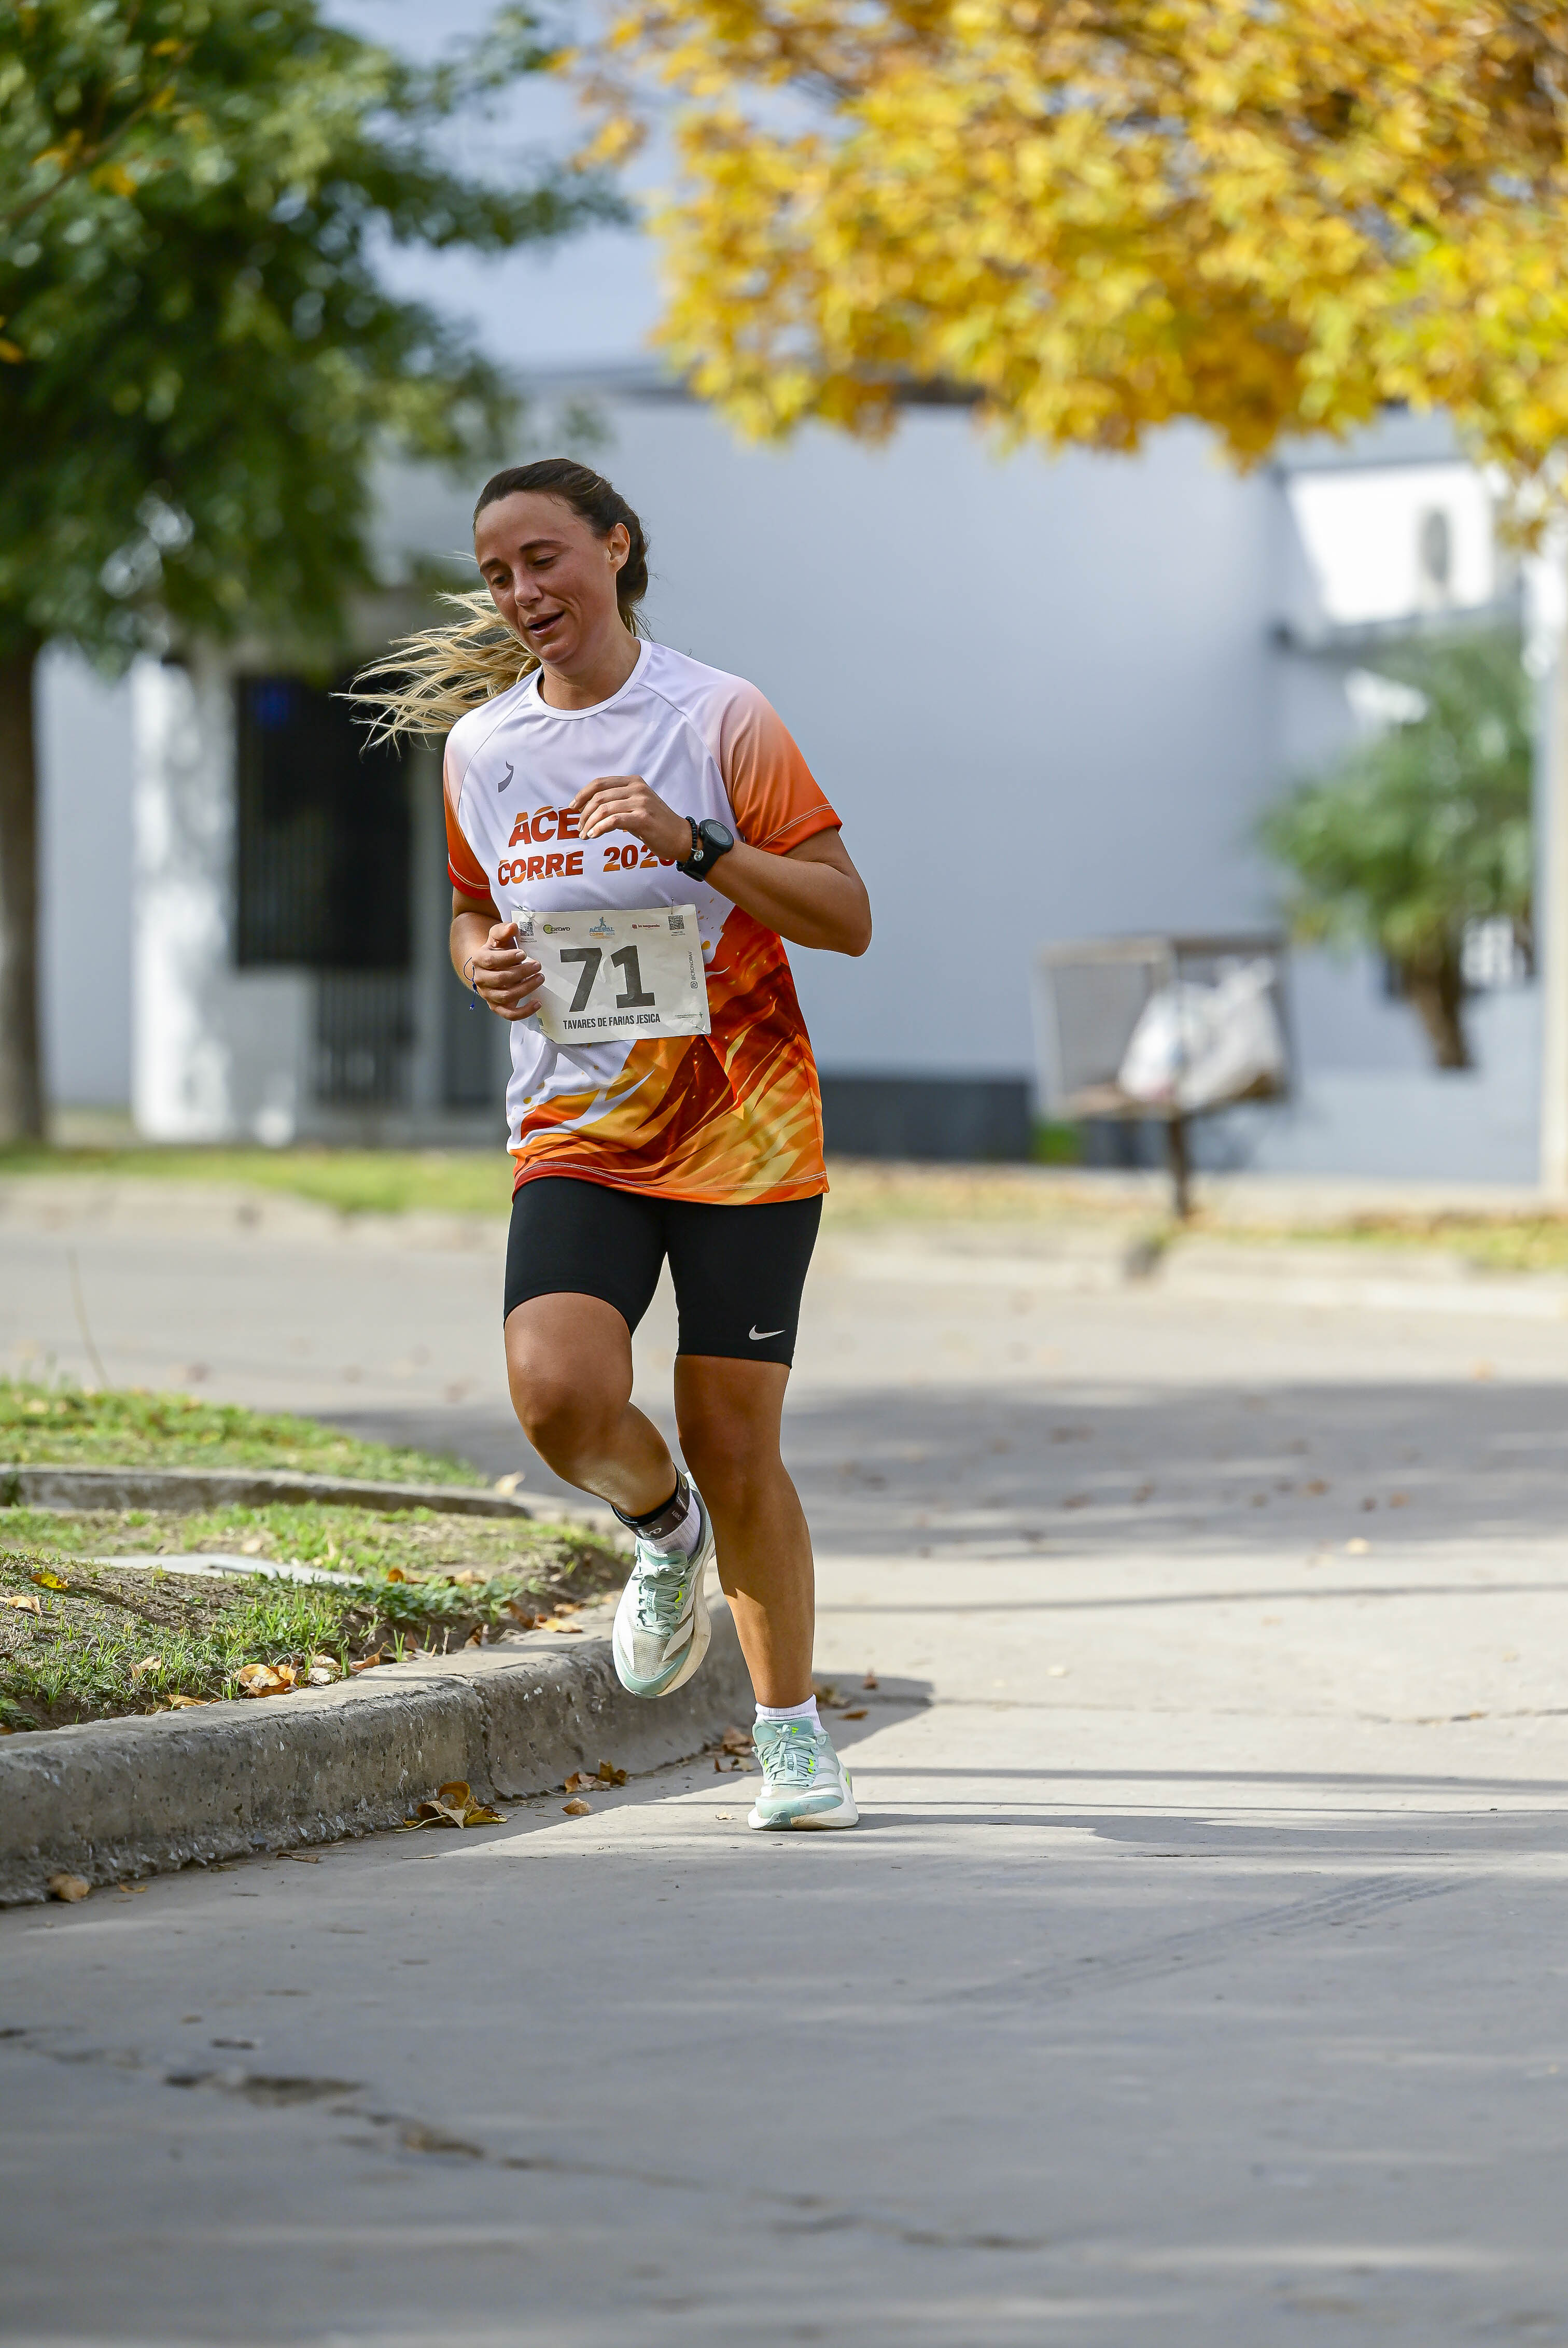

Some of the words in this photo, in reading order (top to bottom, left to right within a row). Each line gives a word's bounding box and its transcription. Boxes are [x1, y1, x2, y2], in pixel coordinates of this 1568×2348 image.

[508, 806, 581, 847] ACE
[498, 851, 584, 886] CORRE
[559, 945, 655, 1012] 71
[688, 951, 696, 981] @CRONORAV
[563, 1018, 596, 1030] TAVARES
[597, 1017, 608, 1027] DE
[609, 1015, 635, 1026] FARIAS
[636, 1013, 661, 1024] JESICA
[786, 1754, 794, 1772] ADIZE
